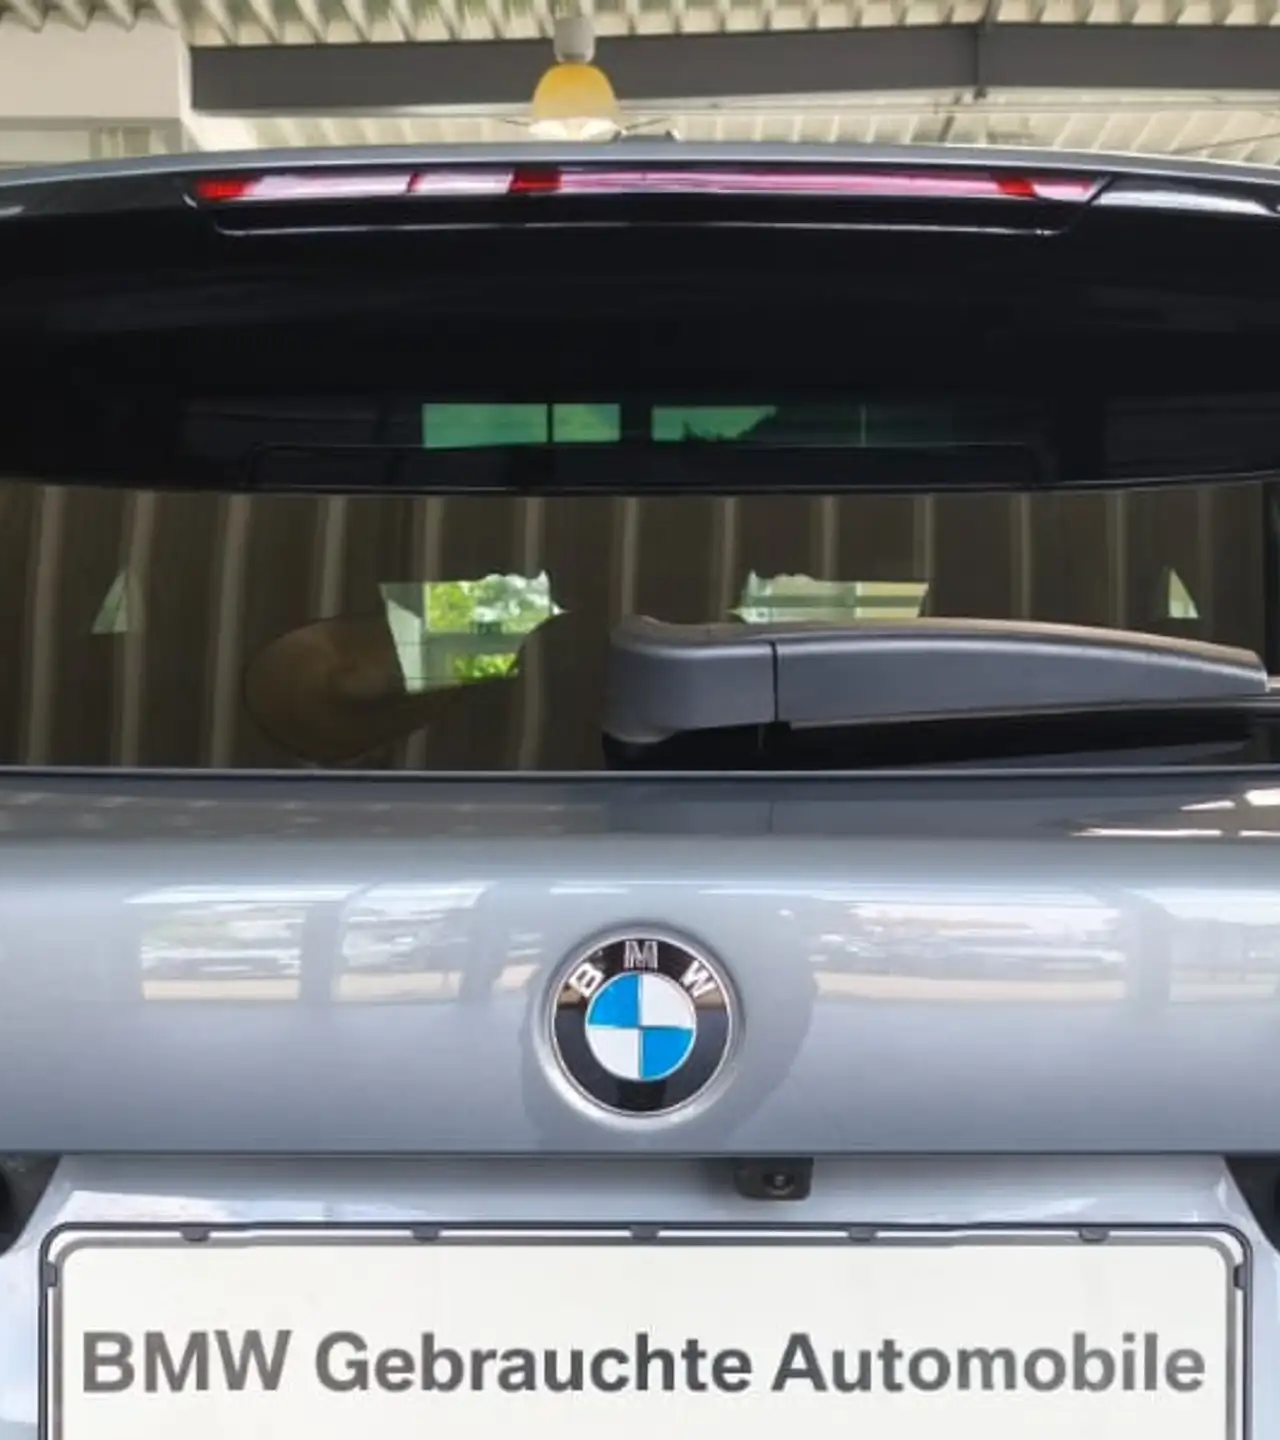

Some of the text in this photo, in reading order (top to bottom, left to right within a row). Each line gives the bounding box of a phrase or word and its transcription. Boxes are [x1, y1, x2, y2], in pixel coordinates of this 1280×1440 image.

[568, 940, 717, 998] BMW
[82, 1329, 1206, 1394] BMW Gebrauchte Automobile
